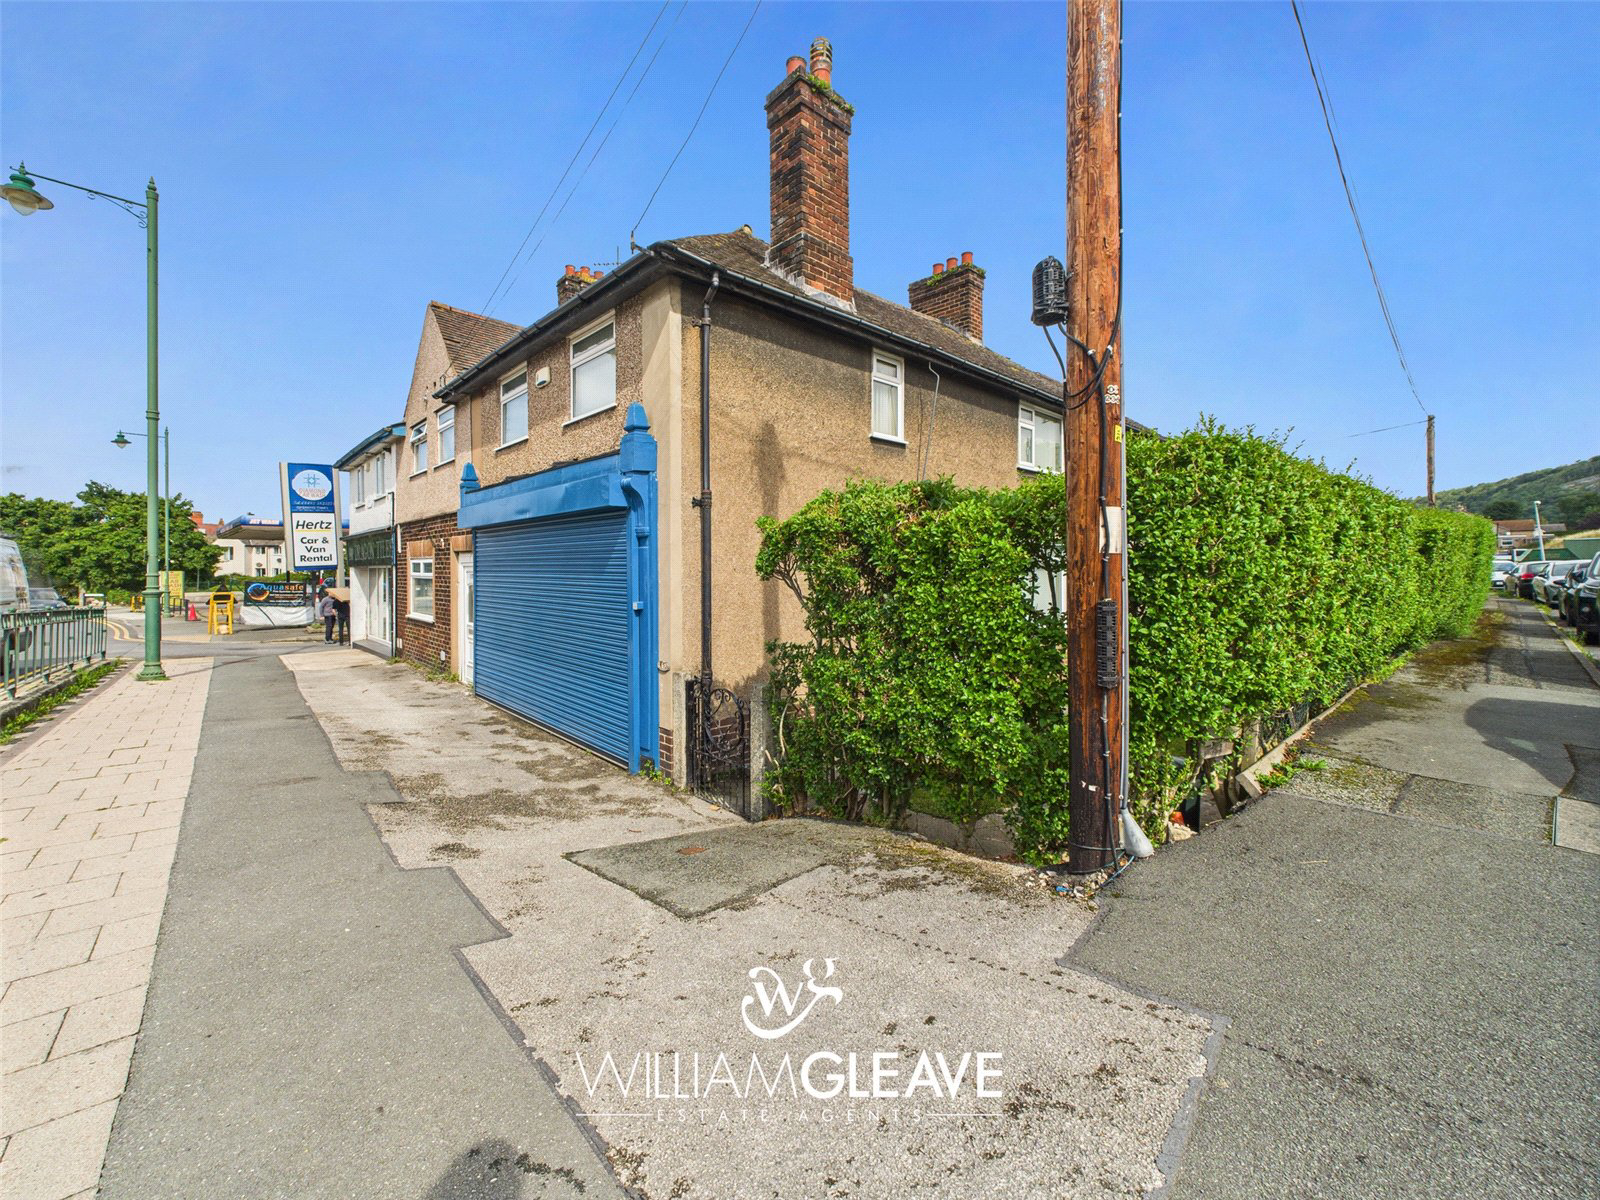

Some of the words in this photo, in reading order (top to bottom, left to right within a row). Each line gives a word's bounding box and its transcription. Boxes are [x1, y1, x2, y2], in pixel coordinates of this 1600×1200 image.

[295, 520, 333, 530] Hertz
[300, 536, 319, 545] Car
[321, 536, 329, 545] &
[304, 545, 326, 553] Van
[299, 554, 333, 563] Rental
[259, 583, 305, 592] Aquasafe
